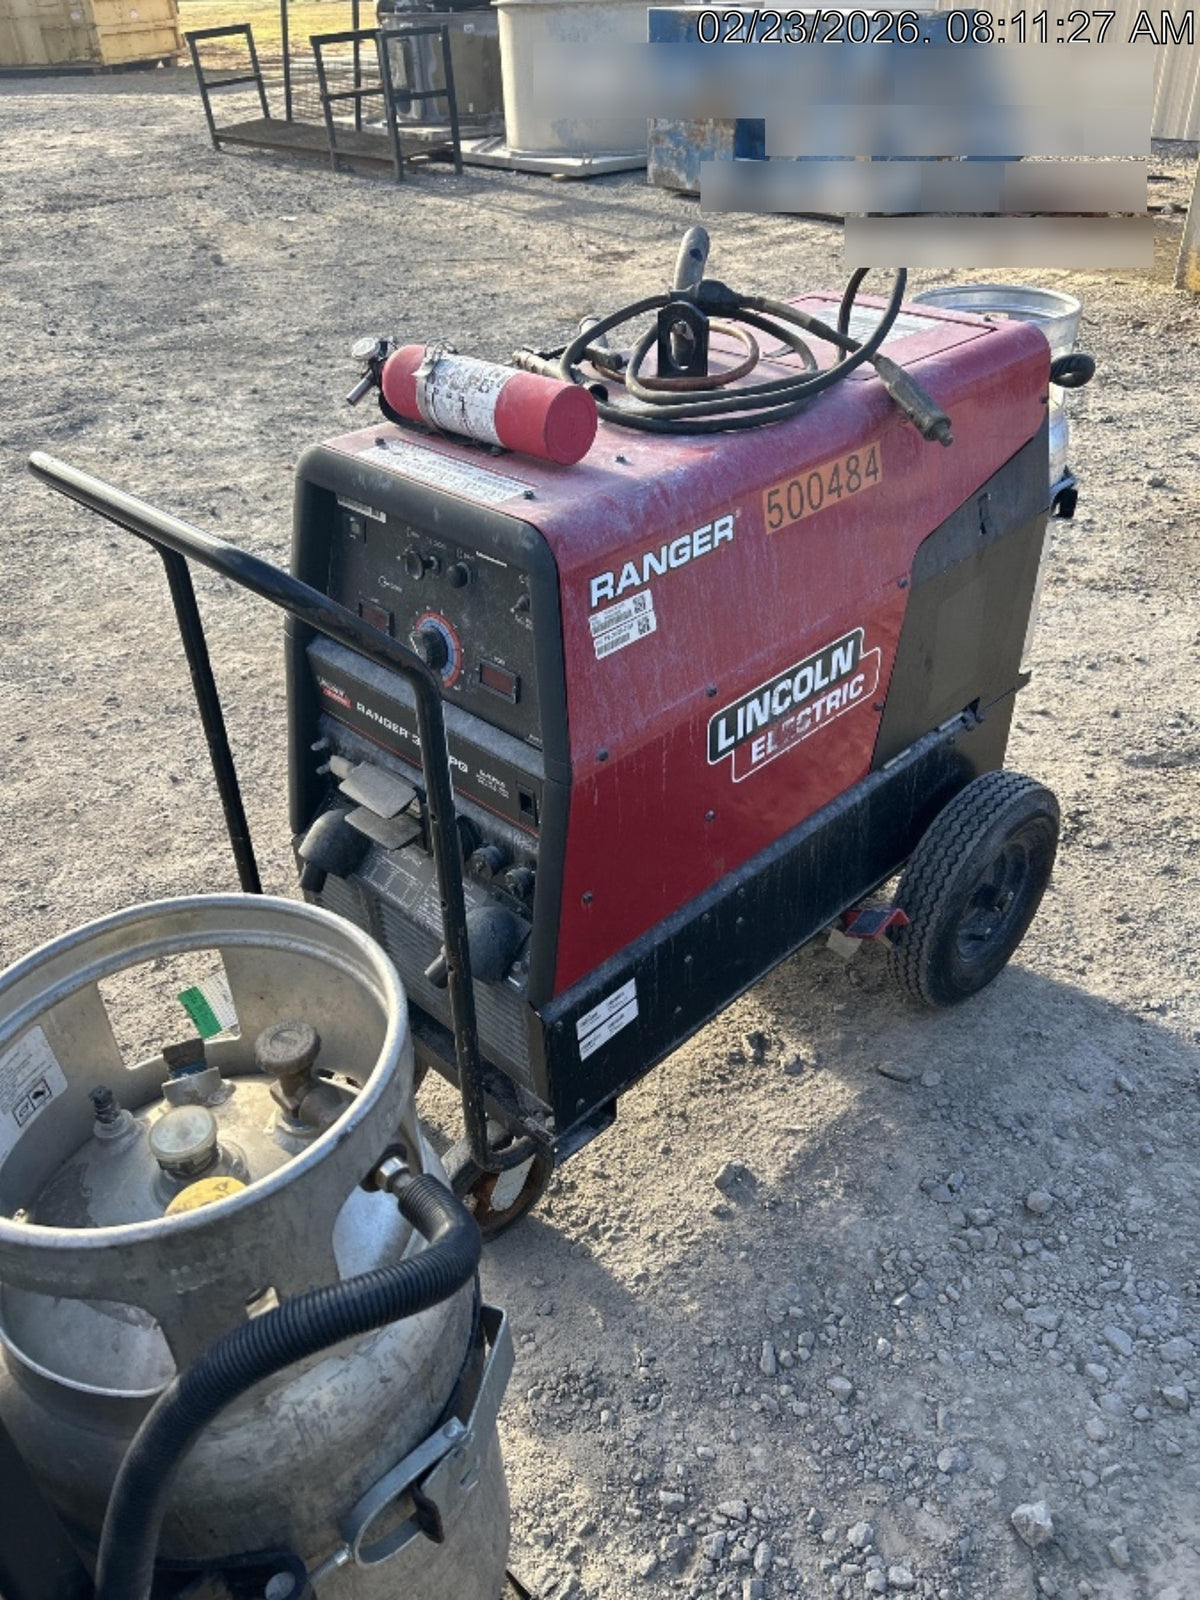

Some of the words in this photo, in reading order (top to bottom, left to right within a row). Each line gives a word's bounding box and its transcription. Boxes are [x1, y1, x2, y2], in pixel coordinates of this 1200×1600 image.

[766, 446, 879, 529] 500484
[589, 513, 735, 608] RANGER
[356, 701, 408, 738] RANGER
[717, 640, 855, 752] LINCOLN
